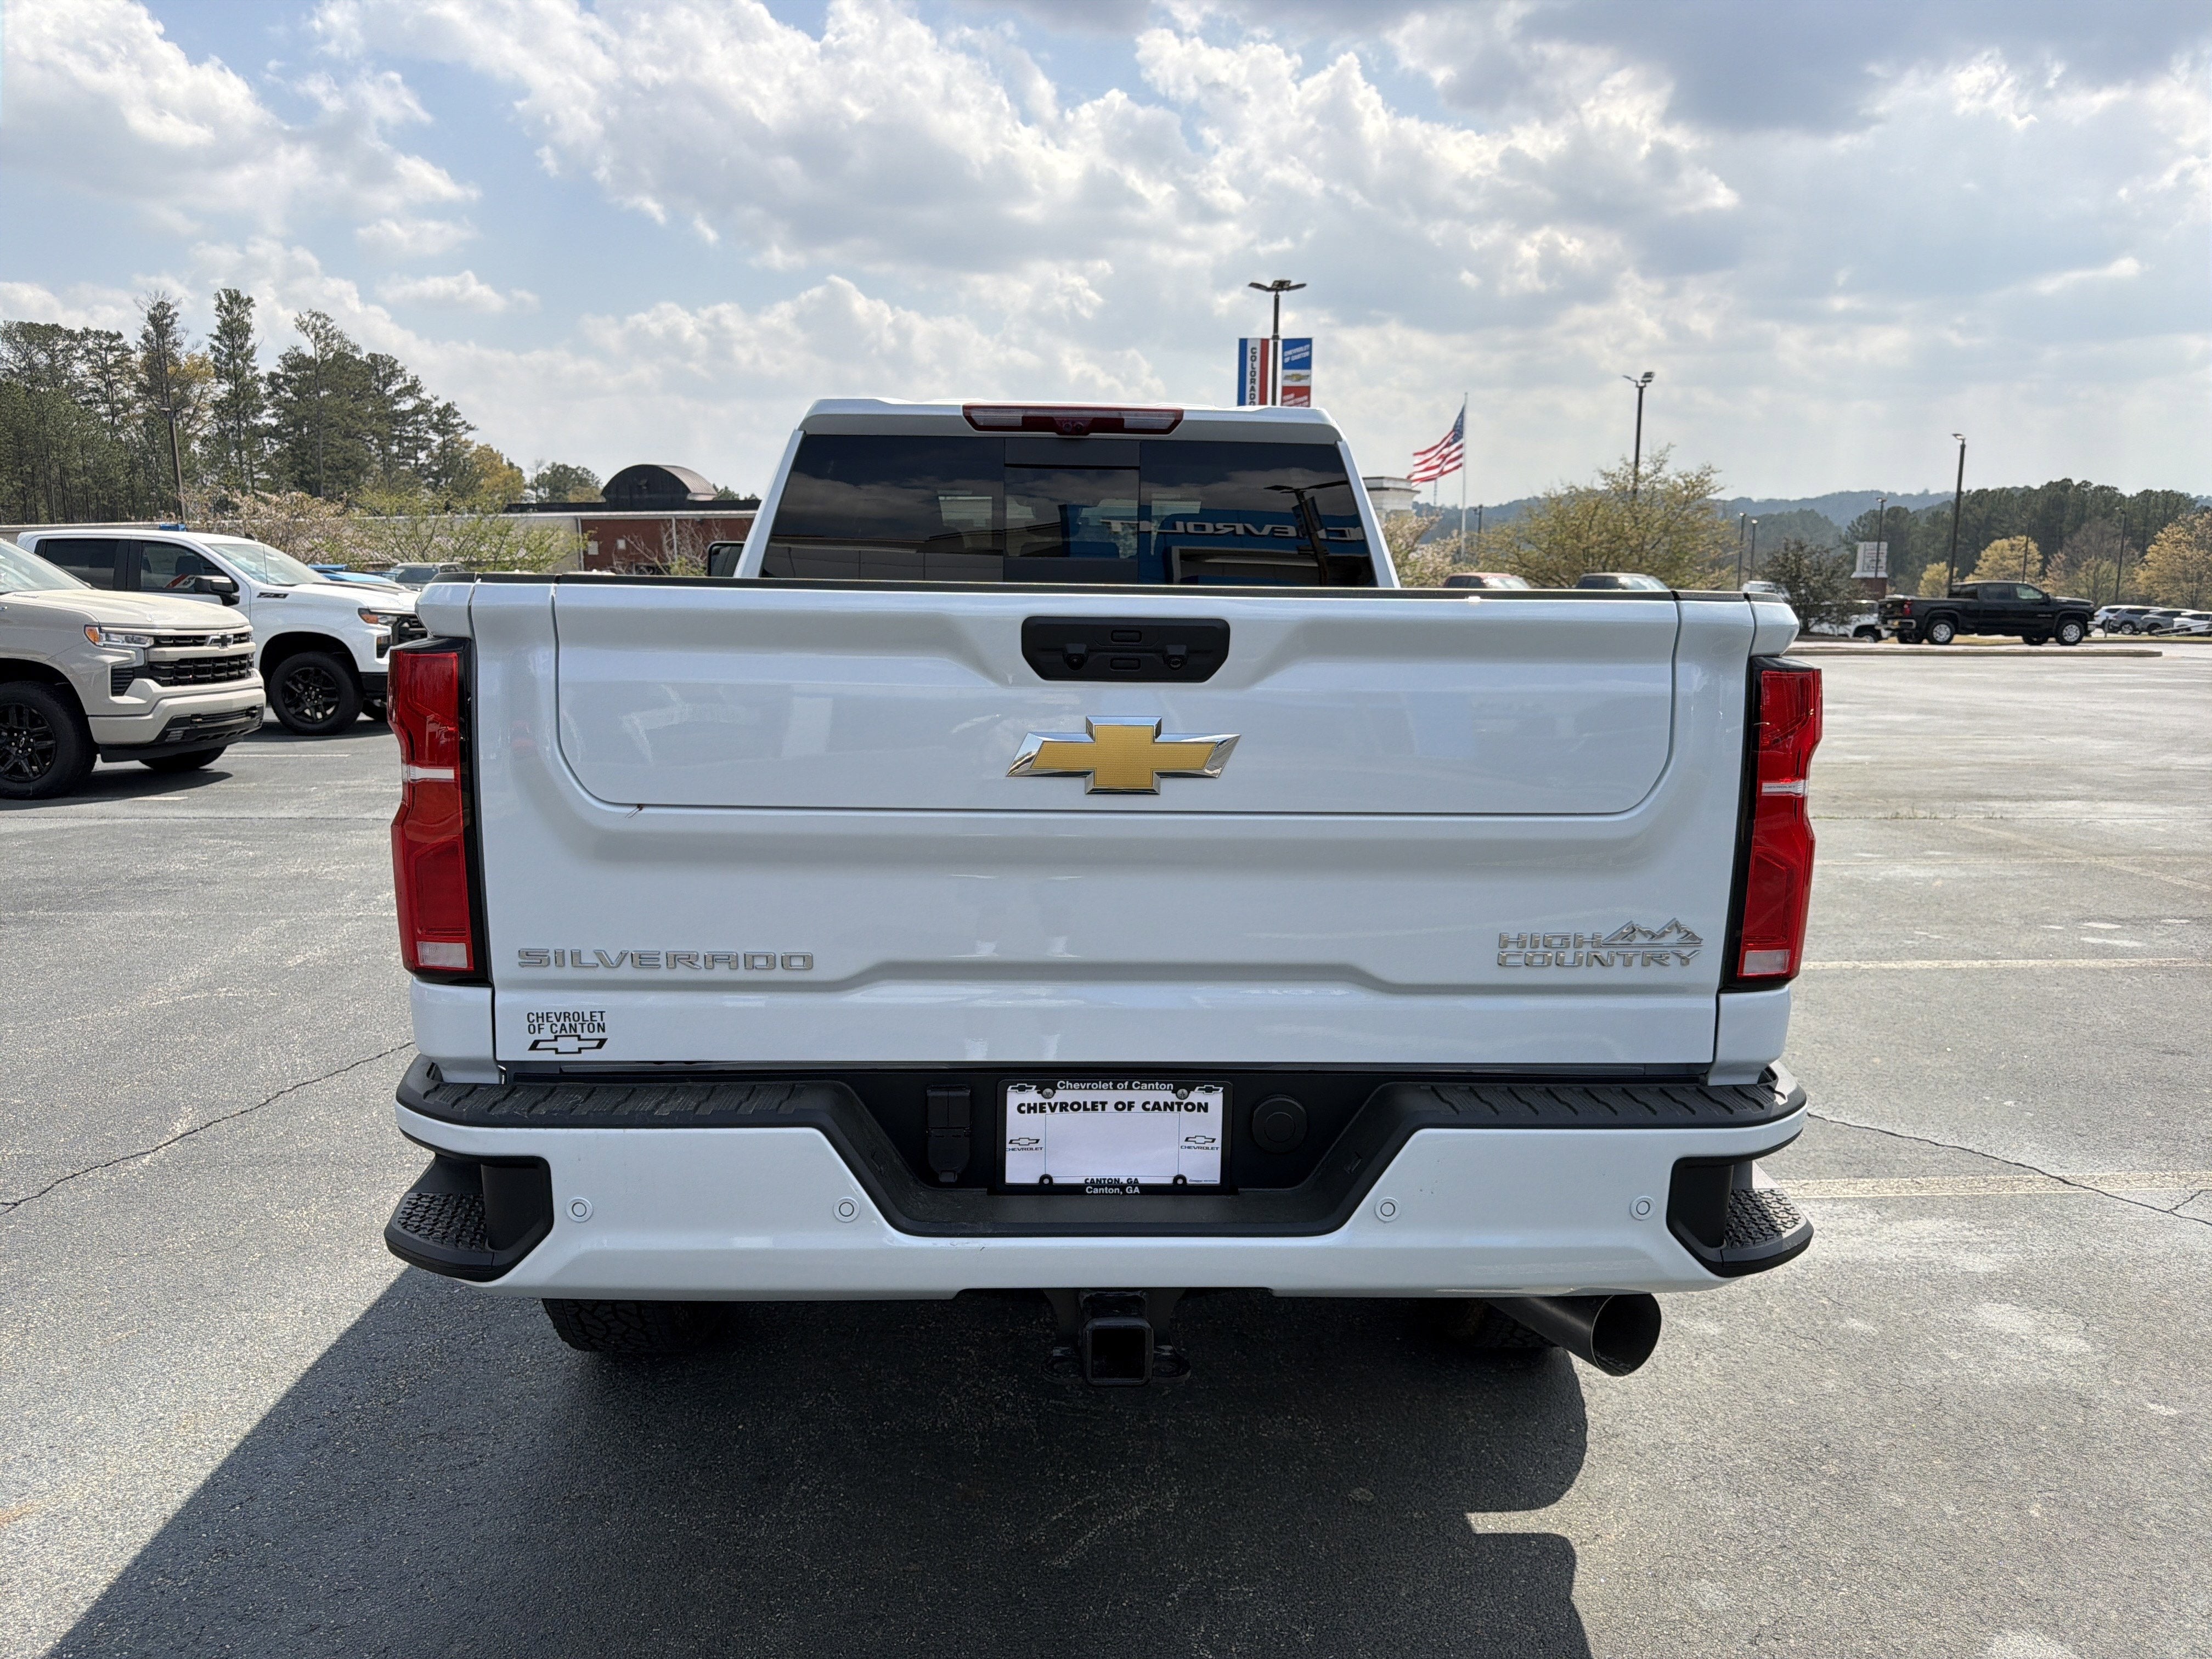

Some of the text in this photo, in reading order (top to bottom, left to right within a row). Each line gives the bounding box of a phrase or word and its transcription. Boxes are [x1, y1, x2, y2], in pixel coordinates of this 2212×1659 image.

[1499, 933, 1602, 949] HIGH
[518, 948, 814, 970] SILVERADO
[1497, 950, 1701, 967] COUNTRY
[527, 1011, 606, 1023] CHEVROLET
[528, 1022, 606, 1034] OF CANTON
[1057, 1080, 1173, 1090] Chevrolet of Canton
[1017, 1099, 1209, 1114] CHEVROLET OF CANTON
[1086, 1186, 1140, 1195] Canton, GA
